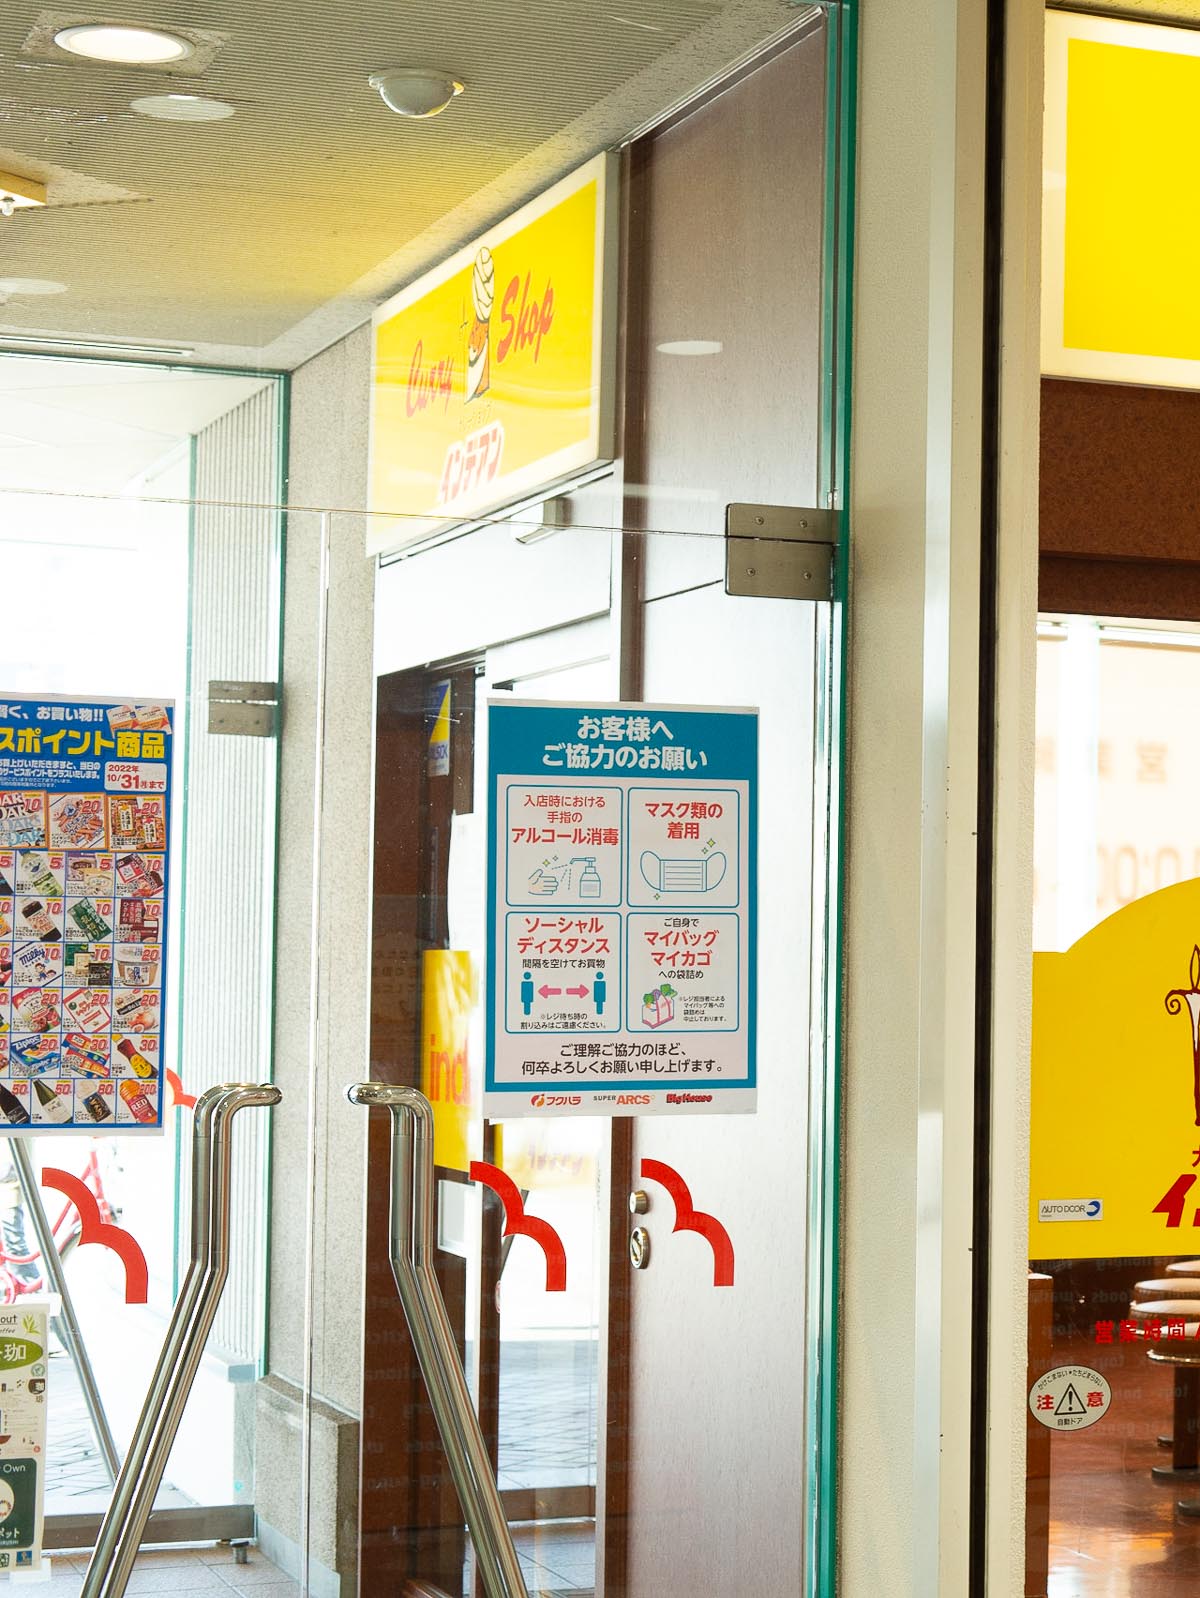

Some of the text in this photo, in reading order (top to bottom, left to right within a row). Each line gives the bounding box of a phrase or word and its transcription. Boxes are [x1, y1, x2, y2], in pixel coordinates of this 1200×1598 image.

[497, 268, 555, 363] Shop
[577, 716, 674, 742] お客様へ
[0, 759, 100, 770] 買上げいただきますと、当日の
[542, 743, 708, 771] ご協力のお願い
[0, 768, 100, 779] サービスポイントをプラスいたします。
[108, 765, 139, 773] 2022年
[524, 794, 606, 808] 入店時における
[547, 811, 583, 824] 手指の
[645, 802, 723, 819] マスク類の
[511, 828, 619, 846] アルコール消毒
[667, 822, 700, 839] 着用
[525, 918, 604, 934] ソーシャル
[663, 918, 699, 928] ご自身で
[517, 937, 610, 955] ディスタンス
[644, 929, 719, 947] マイバッグ
[522, 958, 606, 969] 間隔を空けてお買物
[650, 950, 712, 967] マイカゴ
[659, 969, 704, 980] への袋詰め
[520, 1021, 607, 1030] 割り込みはご遠慮ください。
[560, 1042, 687, 1058] ご理解ご協力のほど、
[521, 1059, 722, 1076] 何卒よろしくお願い申し上げます。
[131, 1097, 147, 1113] RED
[547, 1095, 581, 1105] フクハラ
[616, 1094, 650, 1105] ARCS
[1095, 1318, 1186, 1344] 営業時間
[1057, 1417, 1083, 1426] 自動ドア
[3, 1463, 26, 1473] Own
